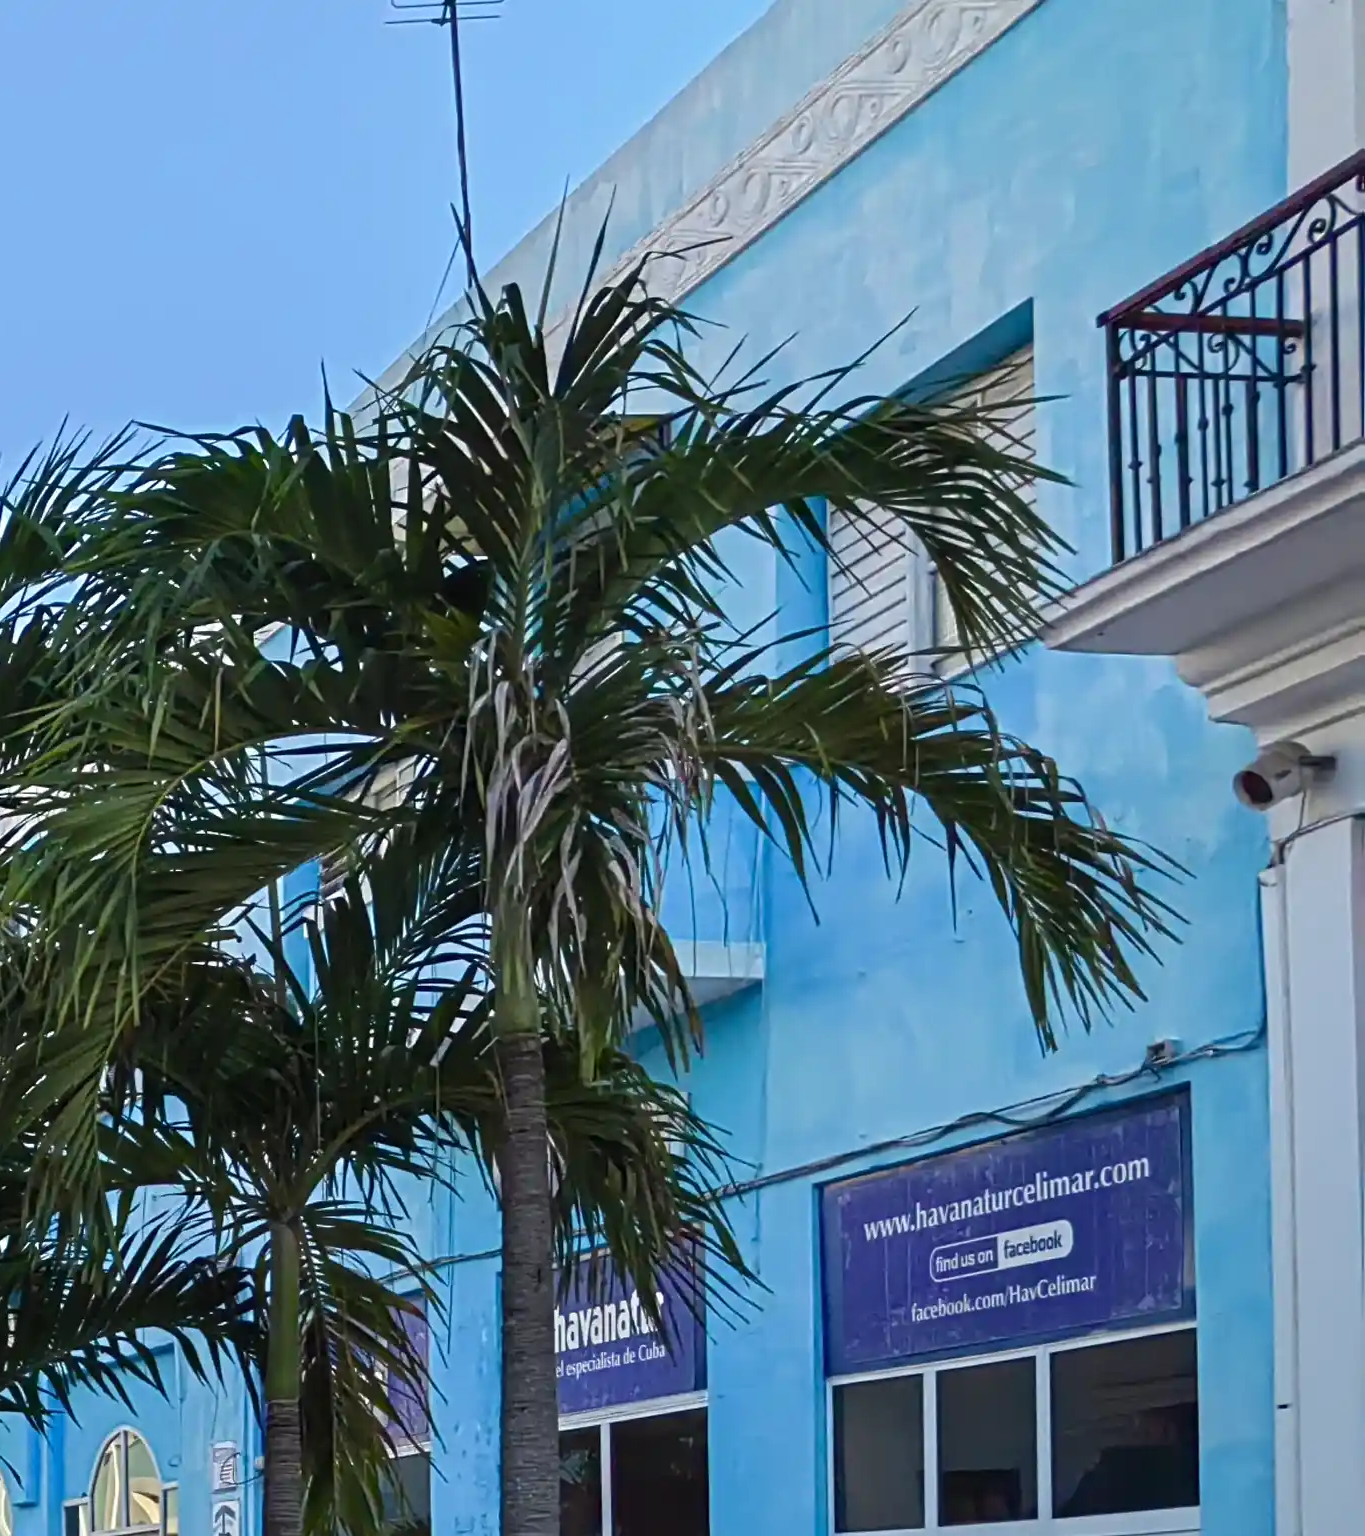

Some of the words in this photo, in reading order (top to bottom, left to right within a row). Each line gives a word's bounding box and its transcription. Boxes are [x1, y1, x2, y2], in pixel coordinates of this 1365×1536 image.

[863, 1157, 1150, 1241] www.havanaturcelimar.com
[935, 1252, 959, 1273] find
[960, 1252, 975, 1267] us
[977, 1248, 994, 1264] on
[1004, 1230, 1063, 1259] facebook
[911, 1274, 1096, 1322] facebook.com/HavCelimar
[566, 1350, 621, 1380] especialista
[623, 1346, 636, 1364] de
[638, 1341, 666, 1362] Cuba
